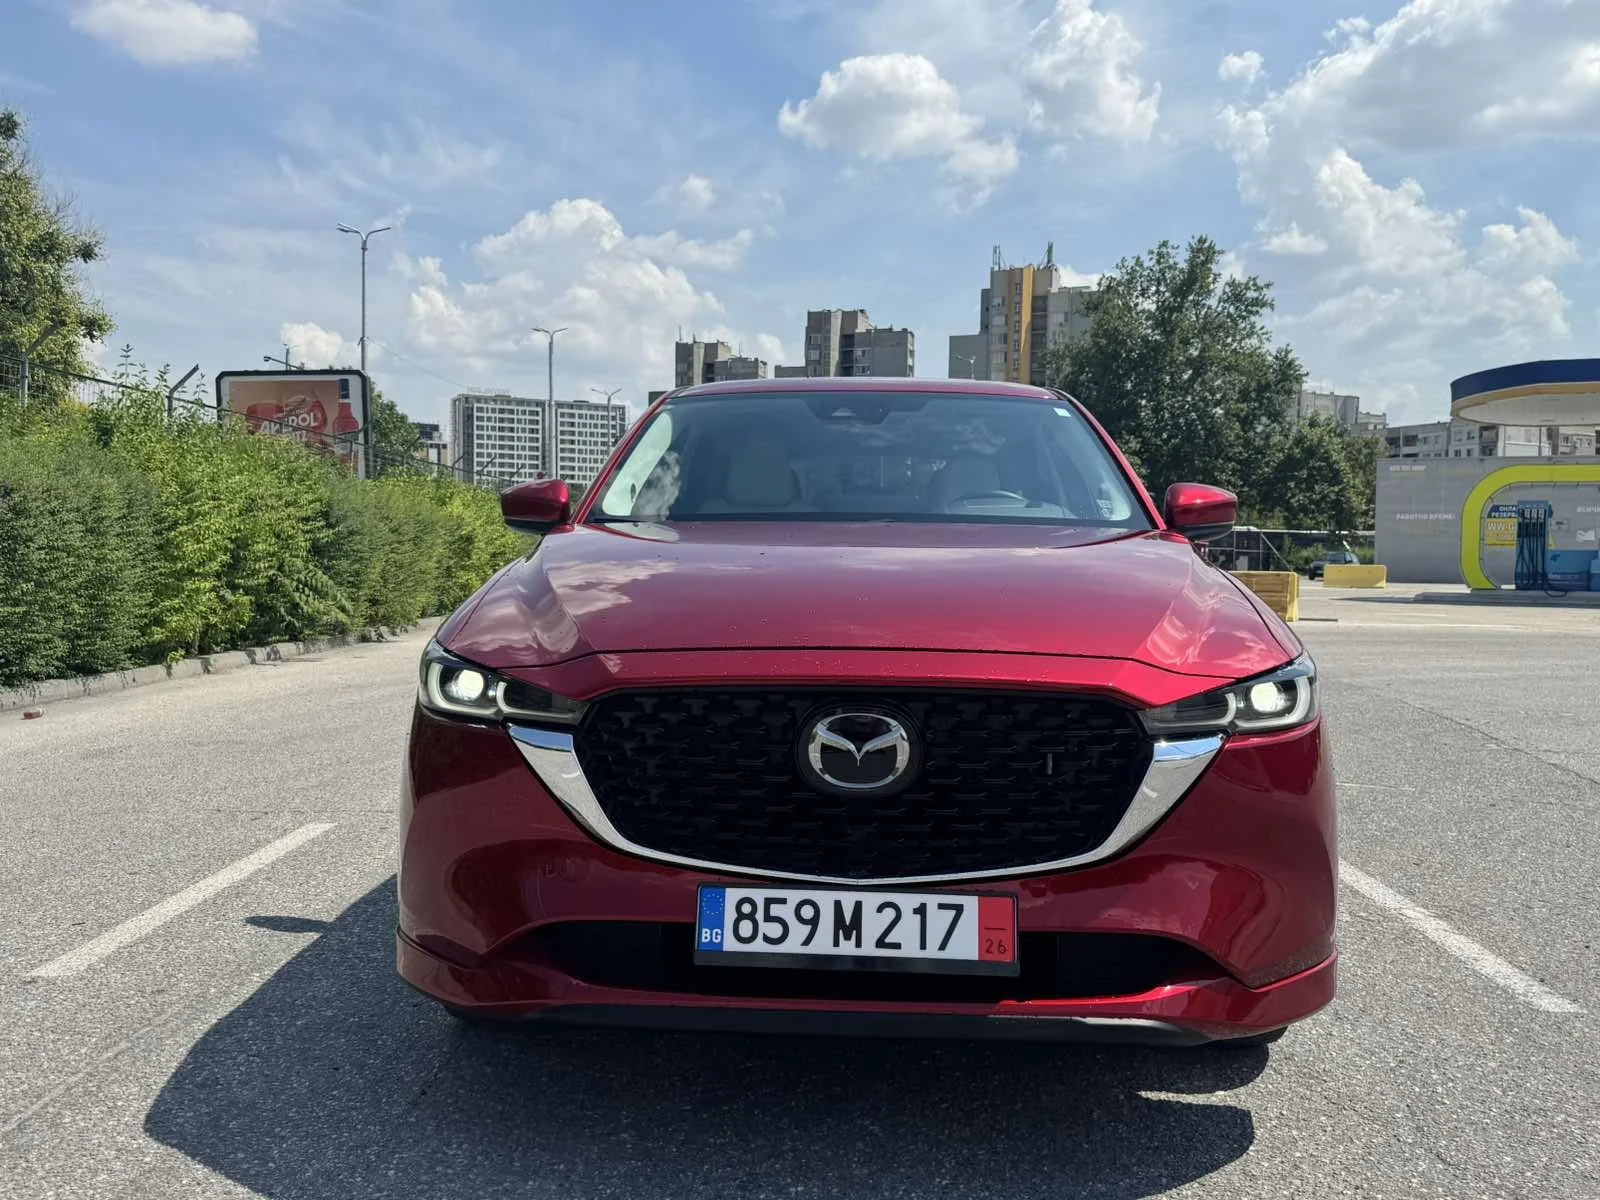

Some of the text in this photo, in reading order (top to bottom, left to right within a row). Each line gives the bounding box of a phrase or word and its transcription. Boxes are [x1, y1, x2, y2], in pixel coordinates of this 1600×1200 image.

[732, 896, 965, 951] 859 M 217
[701, 928, 722, 943] BG
[985, 938, 1007, 954] 26
